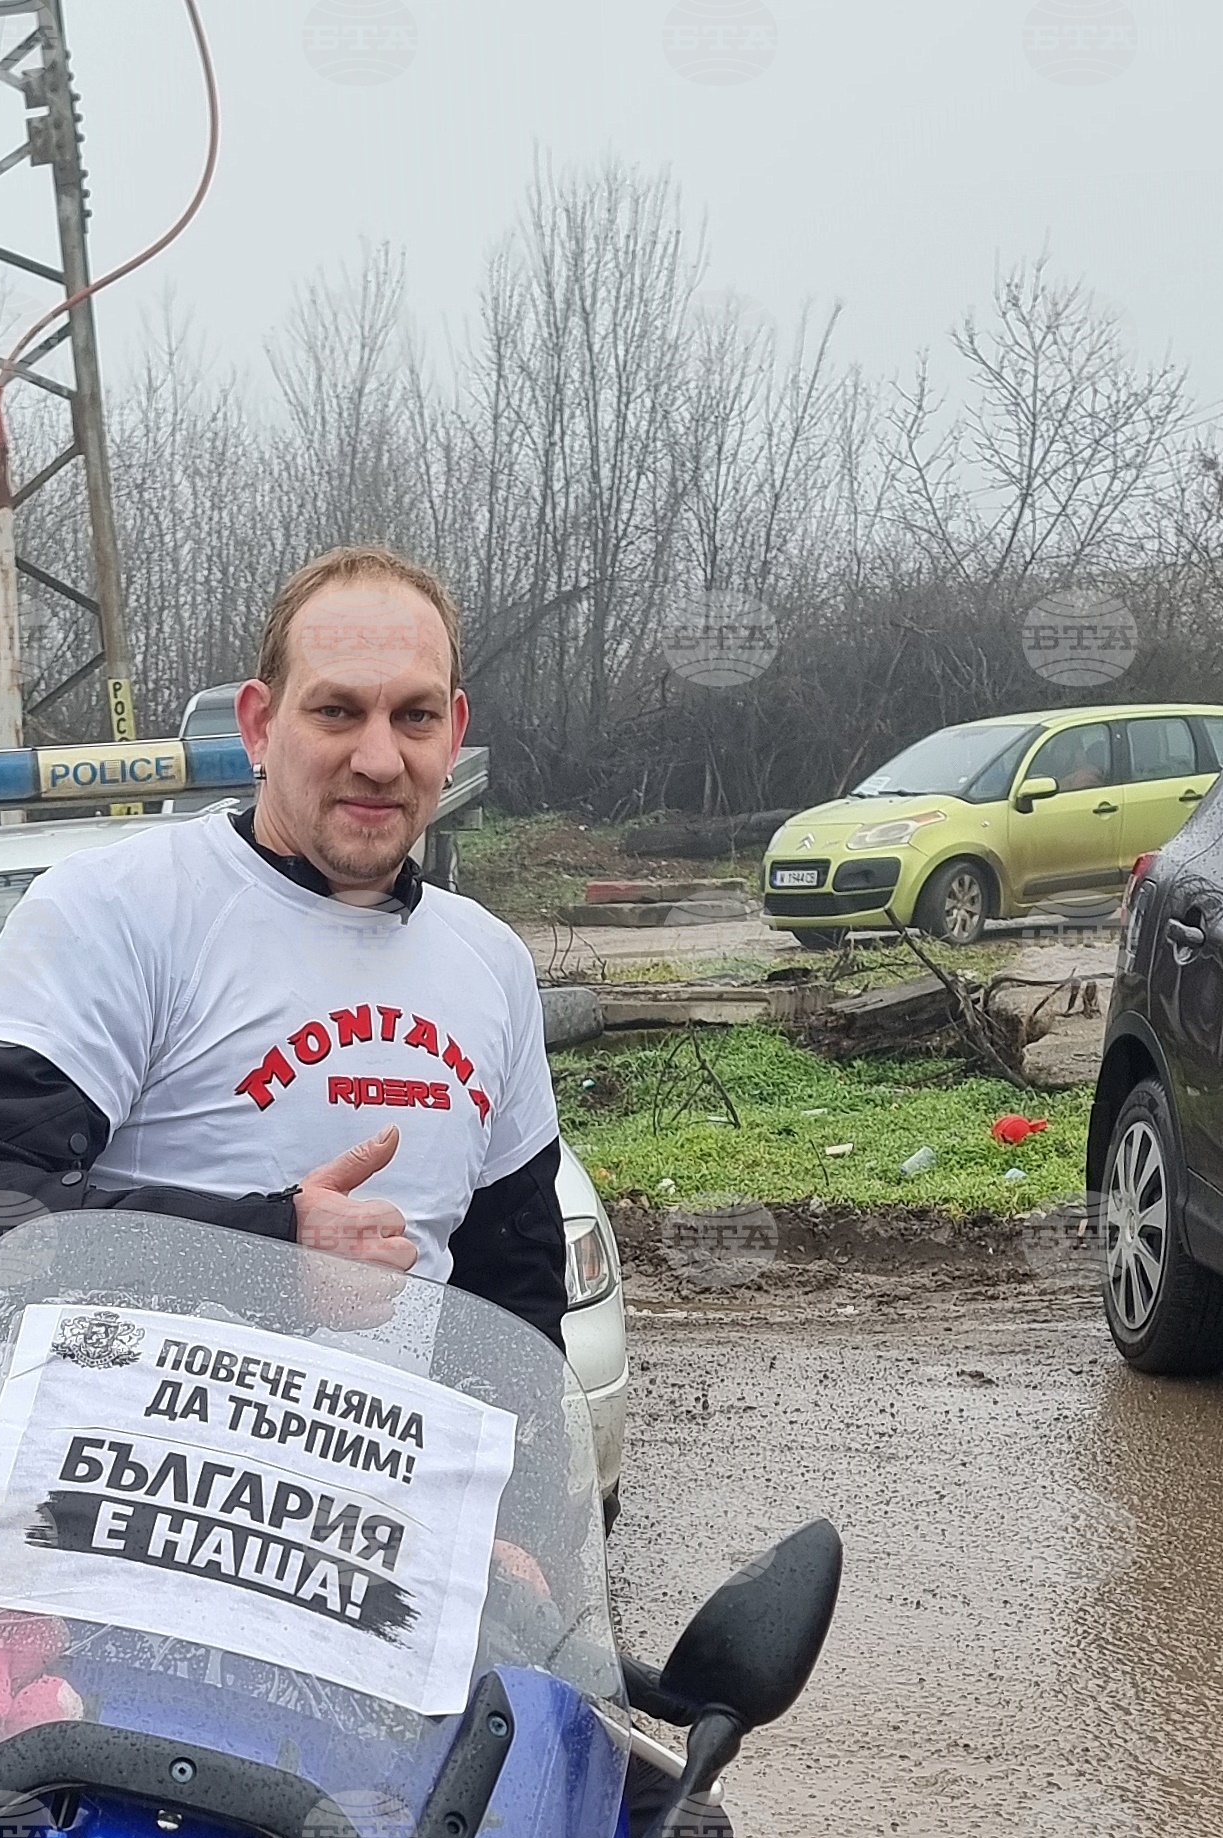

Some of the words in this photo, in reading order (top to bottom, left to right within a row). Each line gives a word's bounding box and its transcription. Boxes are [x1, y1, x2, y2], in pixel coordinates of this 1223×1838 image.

[51, 757, 176, 788] POLICE
[234, 1004, 490, 1127] MONTANA
[328, 1076, 450, 1109] RIDERS
[144, 1380, 209, 1423] ДА
[228, 1395, 416, 1484] ТЪРПИМ!
[155, 1339, 306, 1403] ПОВЕЧЕ
[313, 1379, 424, 1449] НЯМА
[59, 1436, 405, 1572] БЪЛГАРИЯ
[91, 1501, 135, 1551] Е
[147, 1513, 370, 1620] НАША!
